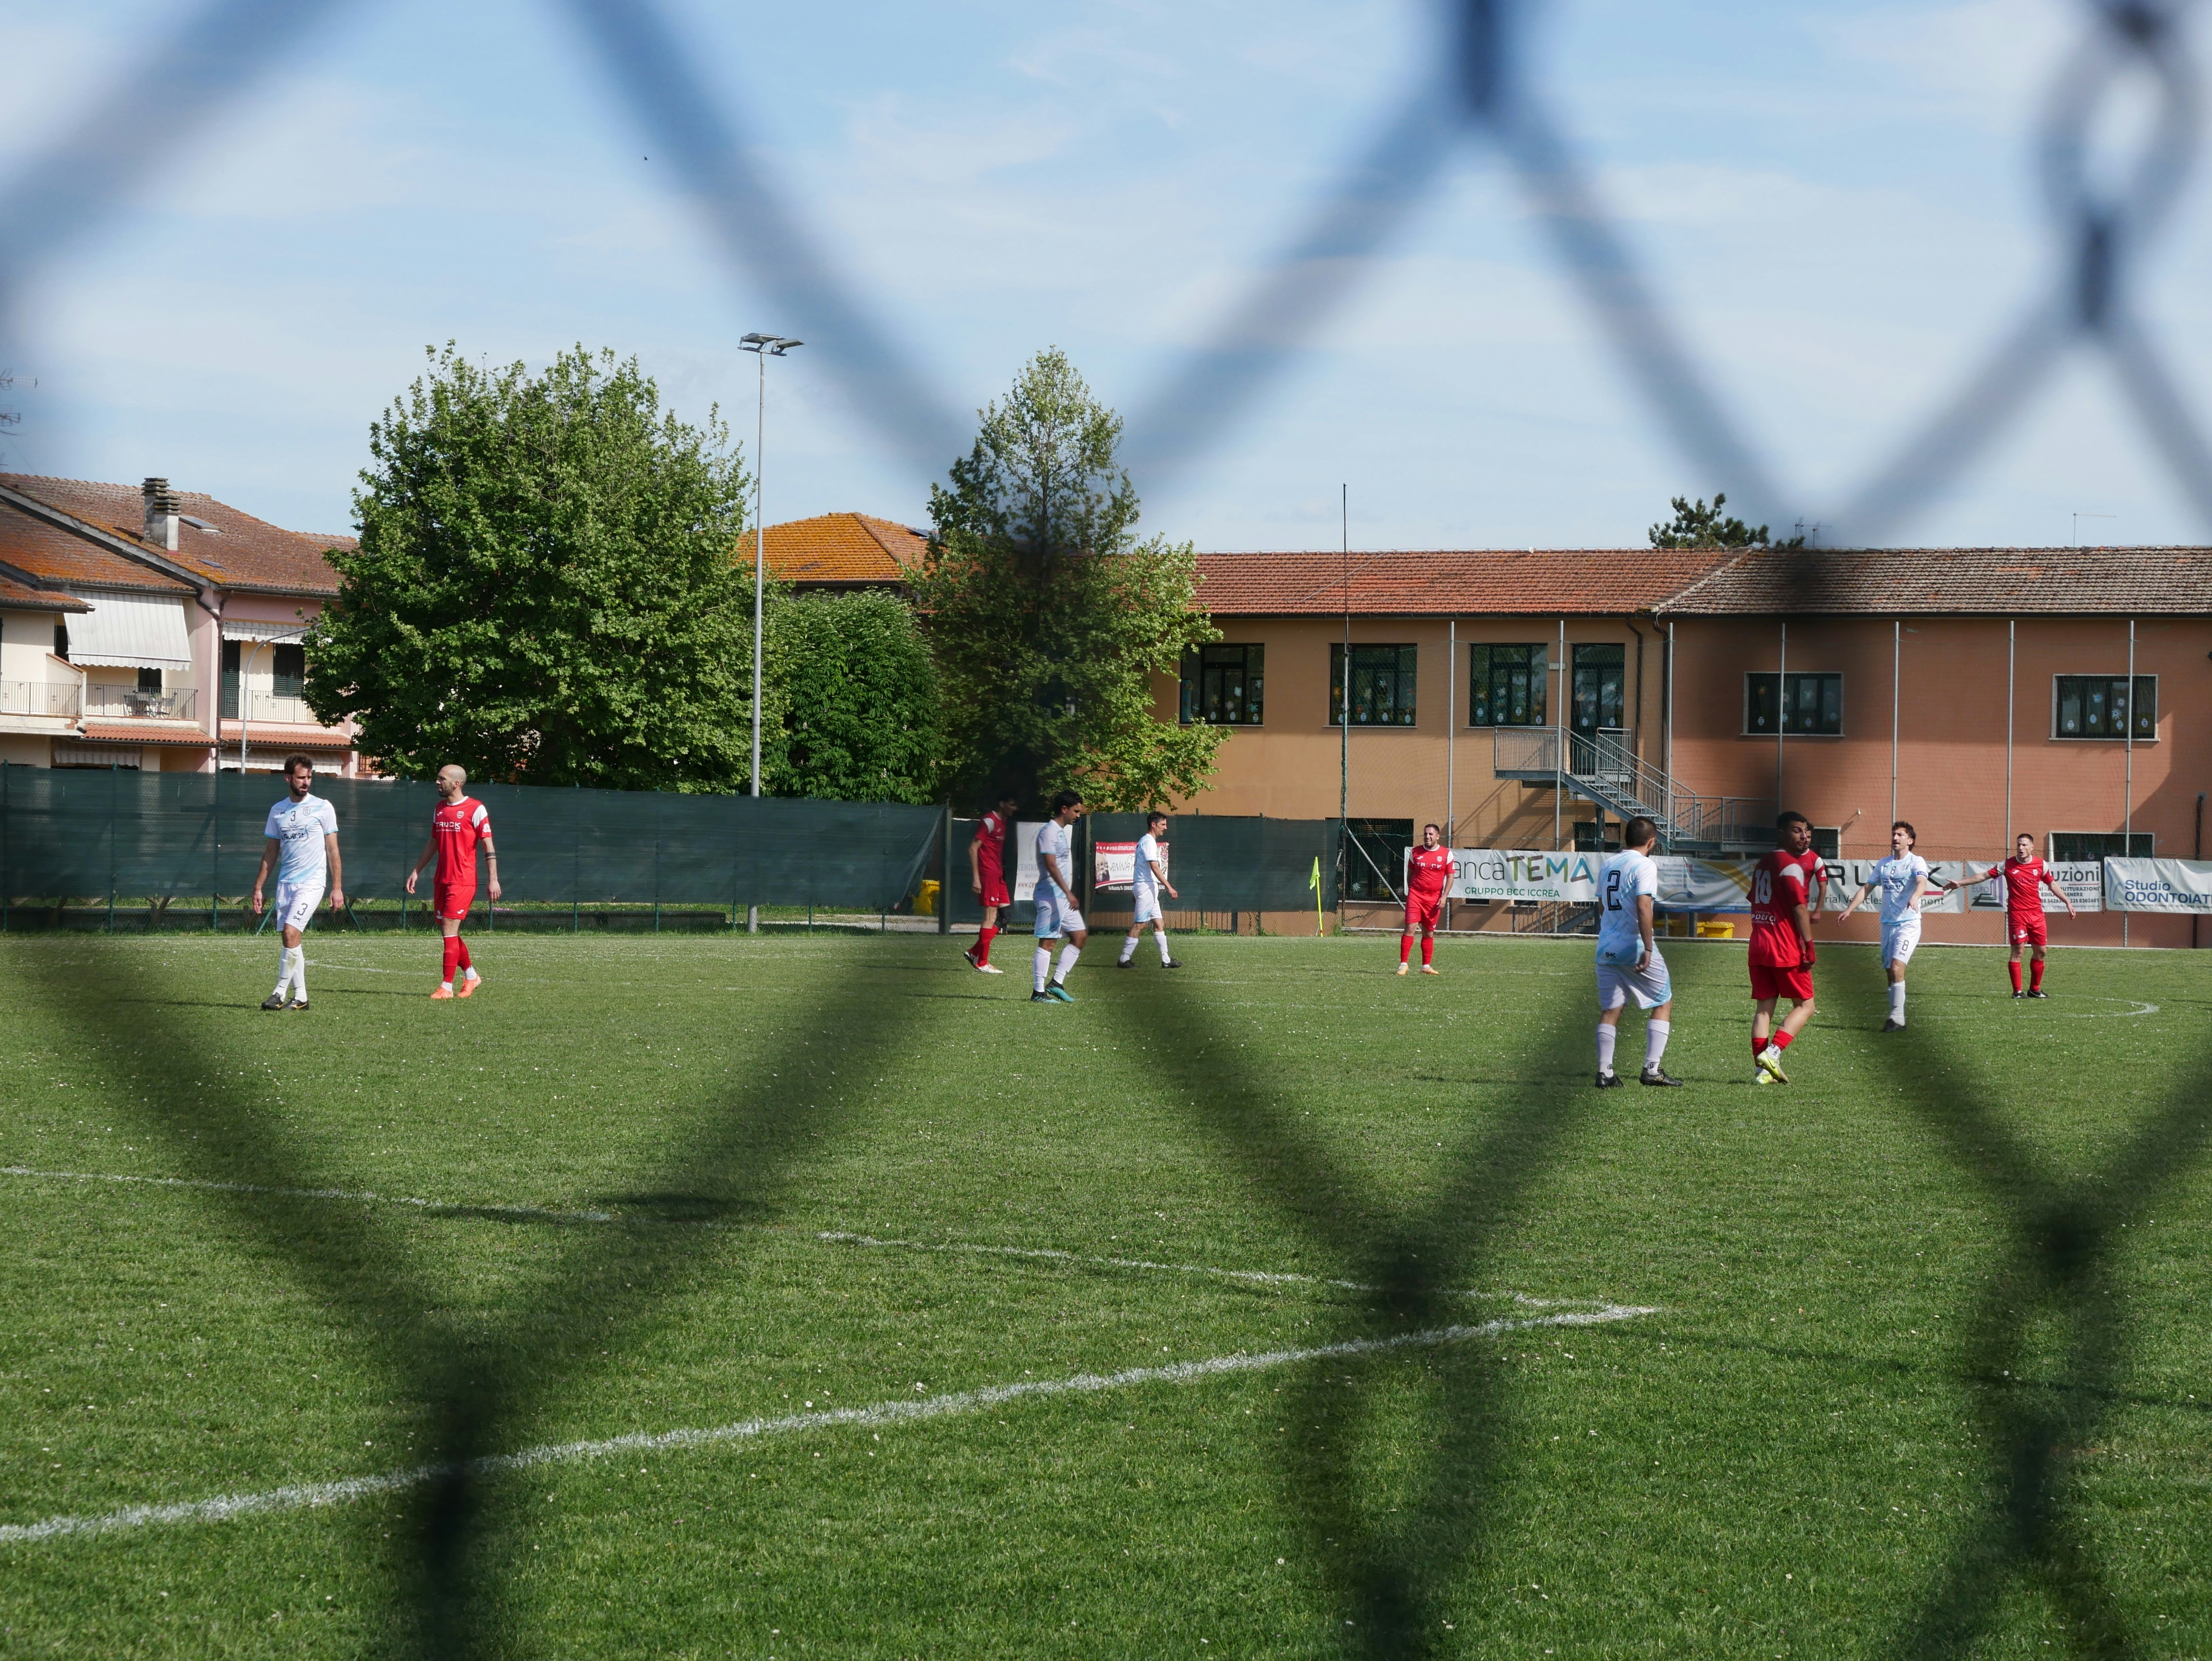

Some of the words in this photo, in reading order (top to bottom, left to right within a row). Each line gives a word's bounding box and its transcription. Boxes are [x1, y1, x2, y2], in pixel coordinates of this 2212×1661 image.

[290, 811, 296, 821] 3
[1453, 855, 1594, 884] ancaTEMA
[1890, 866, 1896, 874] 8
[2052, 867, 2099, 882] uzioni
[1607, 870, 1622, 910] 2
[1755, 869, 1772, 904] 10
[1972, 884, 1989, 892] Euro
[2125, 880, 2171, 891] Studio
[1465, 887, 1503, 895] GRUPPO
[1528, 889, 1560, 897] ICCREA
[2125, 891, 2212, 904] ODONTOIAT
[297, 902, 308, 916] 3
[1902, 940, 1909, 951] 8
